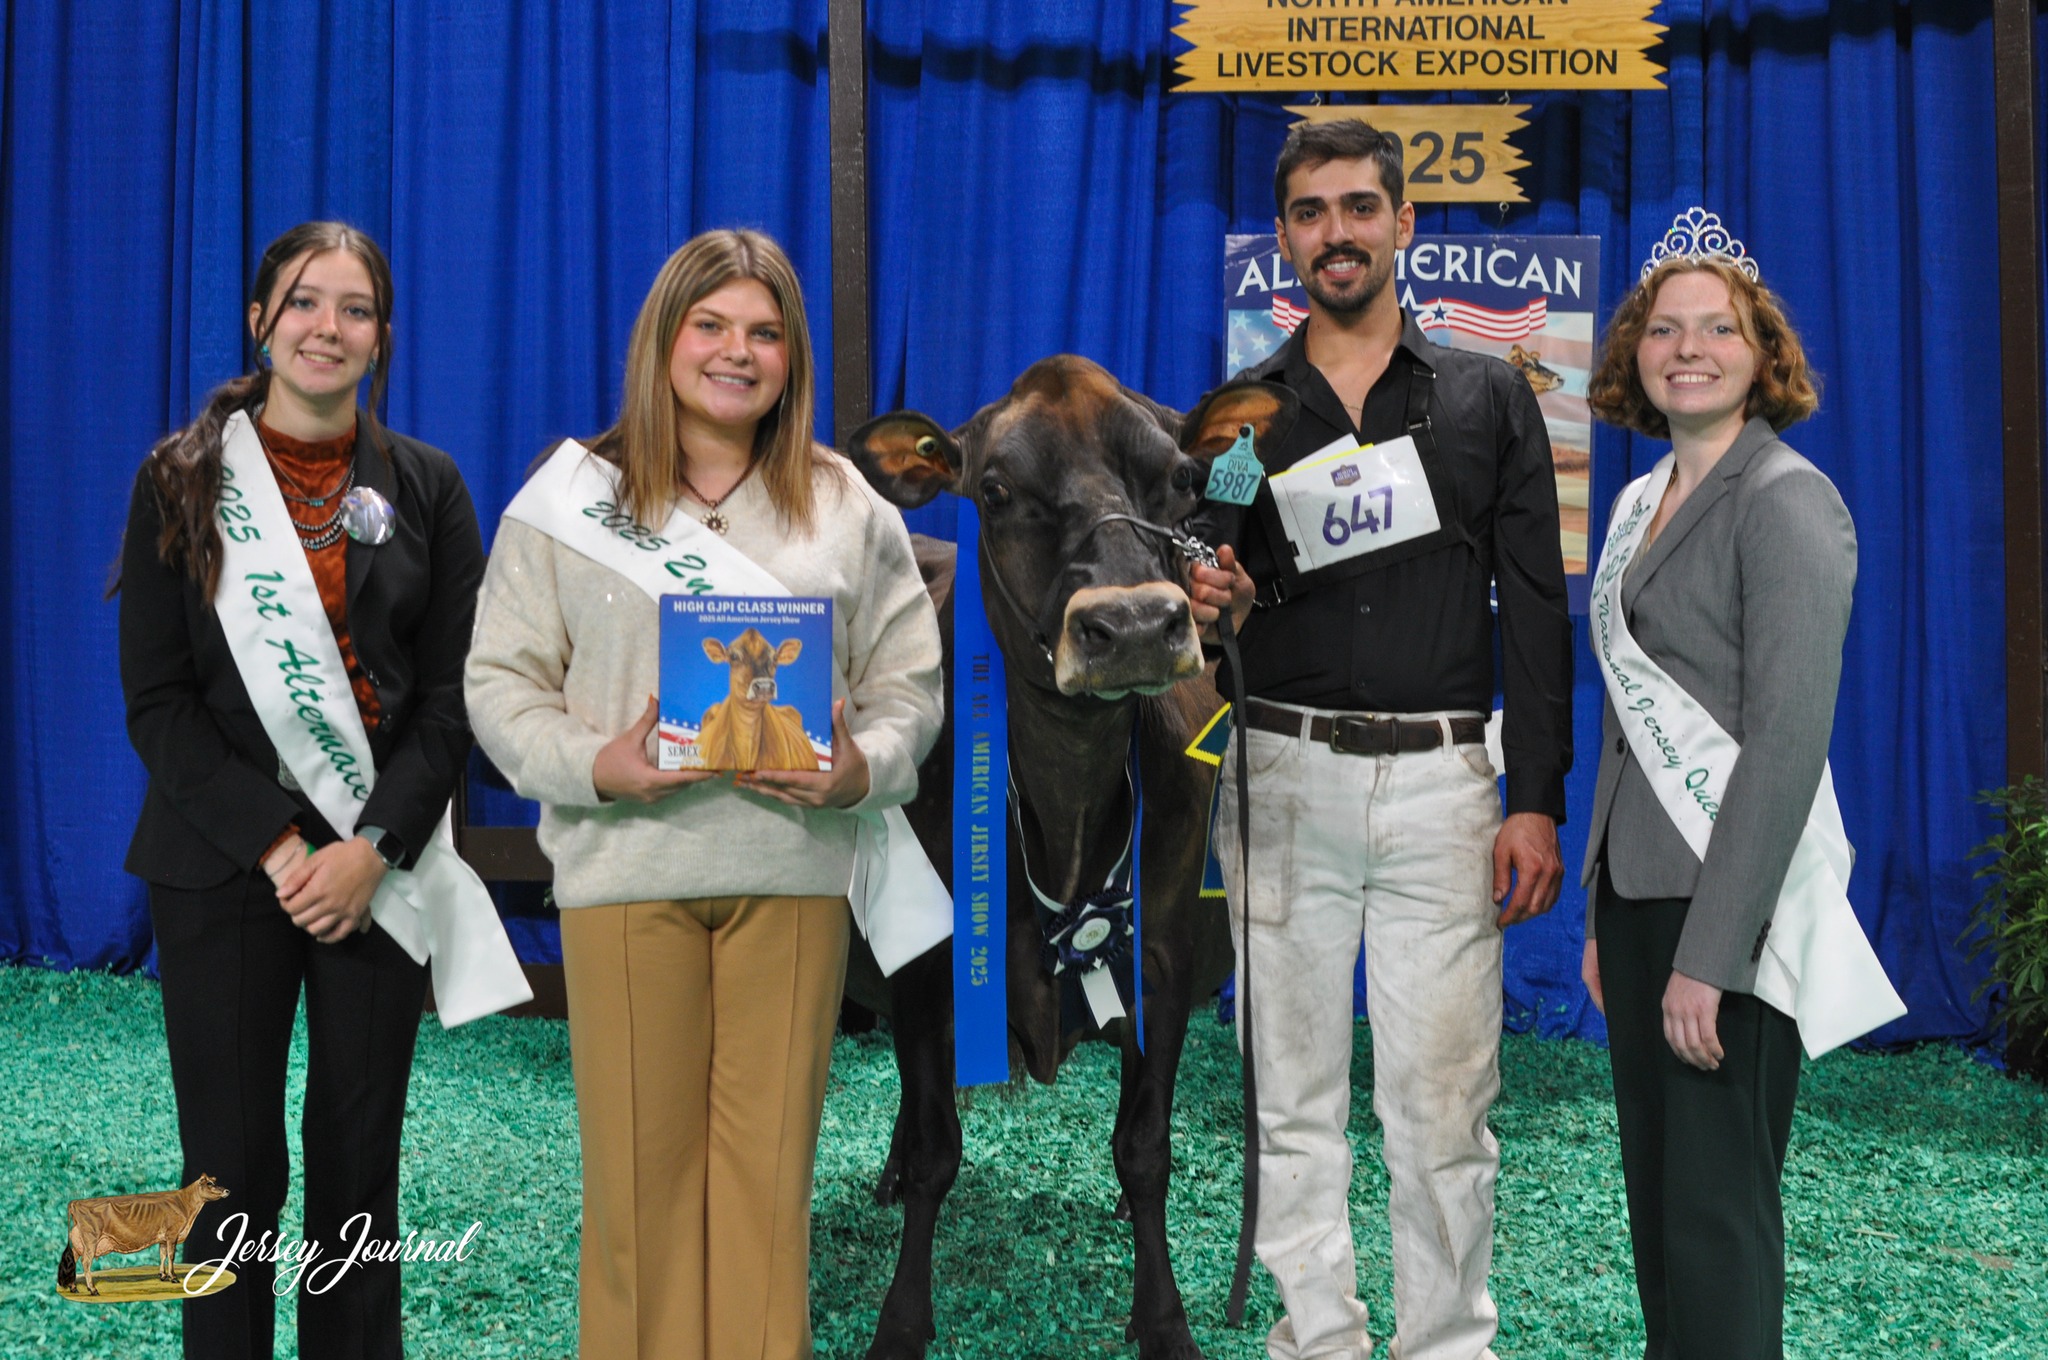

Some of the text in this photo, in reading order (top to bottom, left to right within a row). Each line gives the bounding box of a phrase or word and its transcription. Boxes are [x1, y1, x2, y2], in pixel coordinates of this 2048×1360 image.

[1287, 15, 1545, 42] INTERNATIONAL
[1217, 48, 1618, 79] LIVESTOCK EXPOSITION
[1380, 131, 1485, 185] 25
[1235, 243, 1582, 299] AL ERICAN
[1206, 469, 1259, 501] 5987
[1227, 459, 1249, 473] DIVA
[582, 501, 671, 552] 2025
[1322, 484, 1393, 546] 647
[245, 570, 291, 621] 1st
[673, 600, 826, 615] HIGH GJPI CLASS WINNER
[698, 614, 800, 625] 2025 All American Jersey Show
[667, 745, 699, 757] SEMEX
[1628, 698, 1683, 769] Jersey
[970, 652, 990, 986] THE ALL AMERICAN JERSEY SHOW 2025
